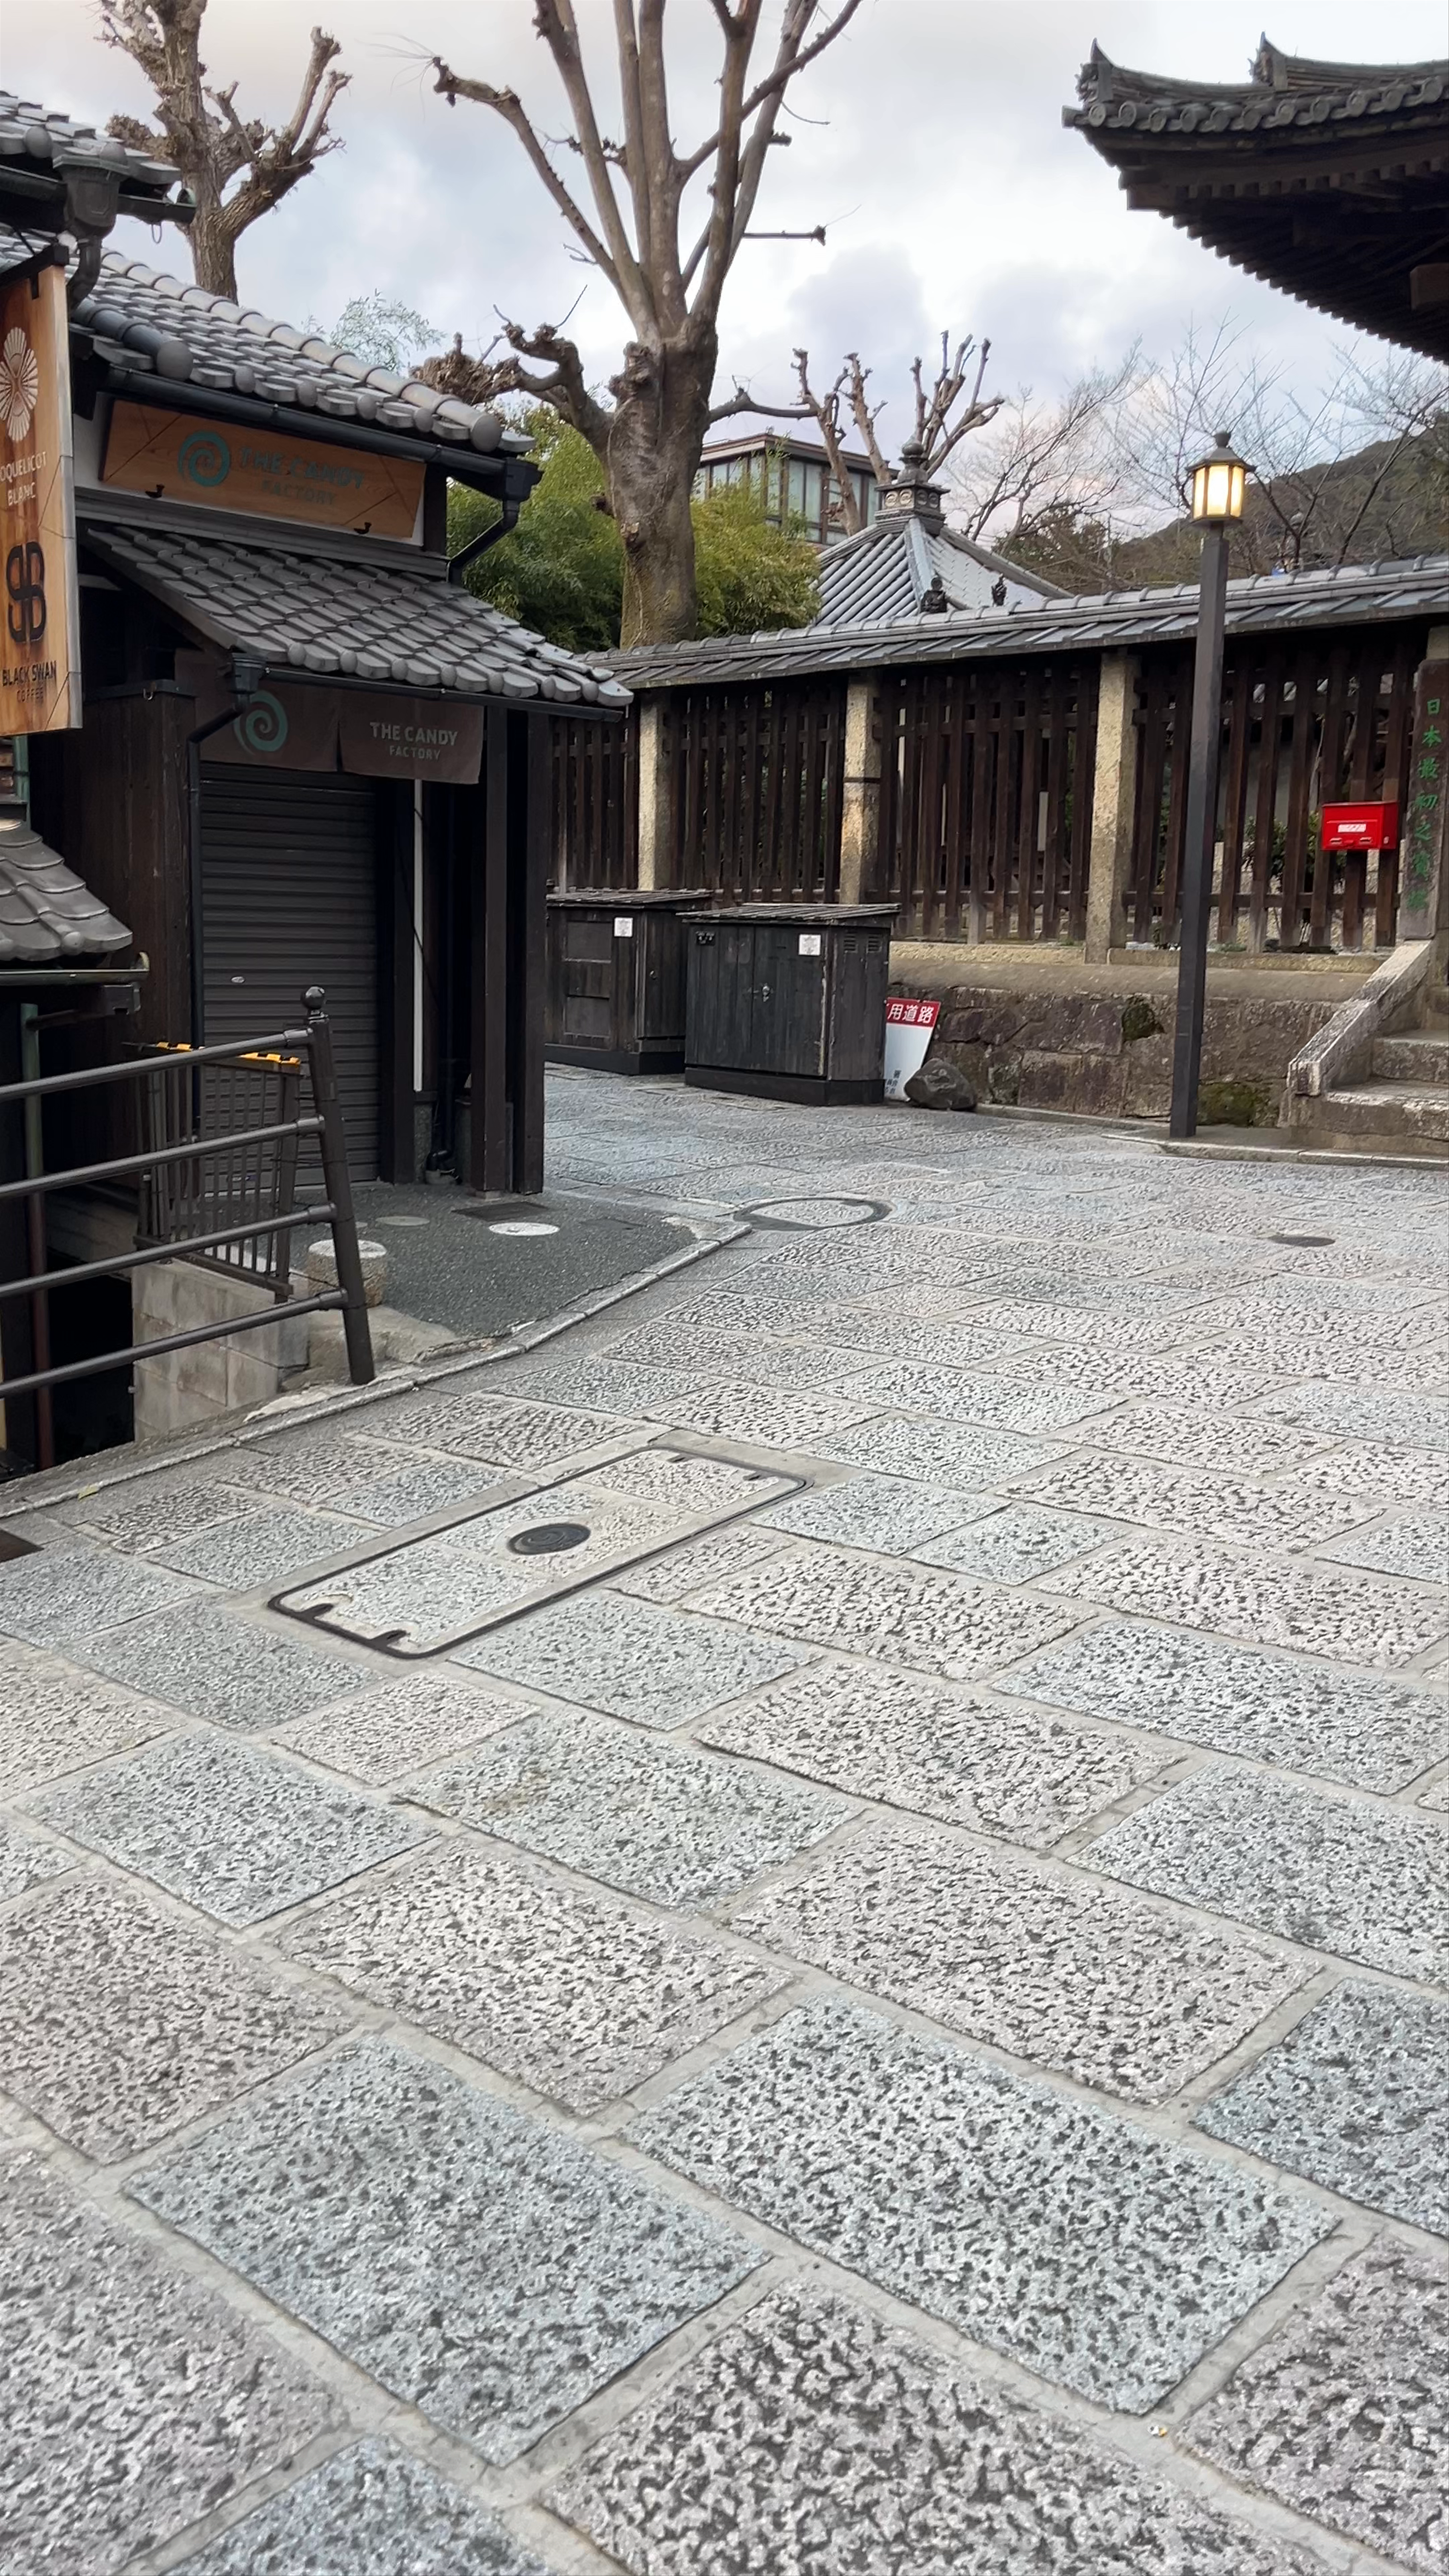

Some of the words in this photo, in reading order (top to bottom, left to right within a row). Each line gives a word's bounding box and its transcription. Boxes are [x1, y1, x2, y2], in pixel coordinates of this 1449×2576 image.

[0, 451, 46, 483] OQUELICOT
[241, 447, 282, 474] THE
[290, 457, 365, 489] CANDY
[8, 482, 35, 506] BLANC
[3, 666, 30, 687] BLACK
[32, 660, 57, 681] SWAN
[17, 687, 43, 703] COFFEE
[370, 722, 400, 740] THE
[405, 726, 458, 746] CANDY
[389, 745, 440, 760] FACTORY
[887, 1003, 935, 1023] 用道路
